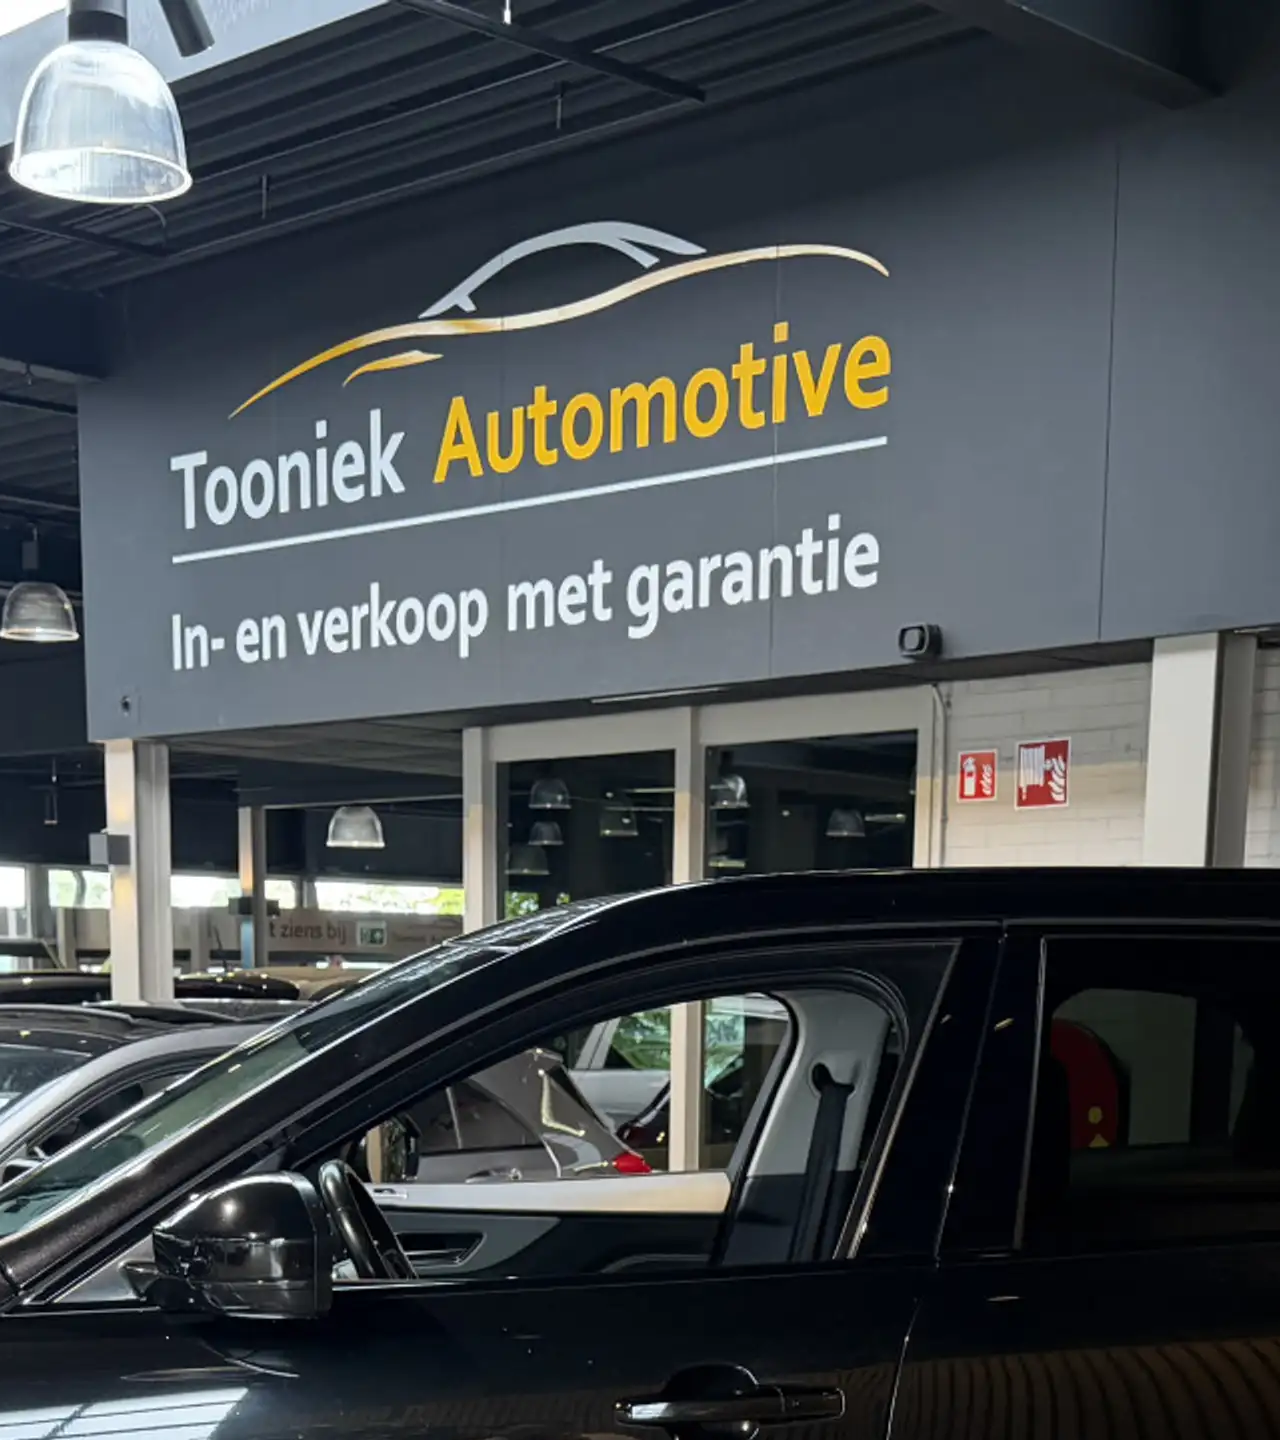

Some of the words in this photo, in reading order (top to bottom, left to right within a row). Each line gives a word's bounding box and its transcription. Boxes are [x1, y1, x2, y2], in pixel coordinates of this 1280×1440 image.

[171, 408, 406, 530] Tooniek
[433, 321, 892, 484] Automotive
[172, 613, 225, 671] In-
[236, 614, 287, 664] en
[297, 582, 489, 659] verkoop
[508, 560, 613, 632] met
[627, 514, 880, 640] garantie
[280, 919, 323, 939] ziens
[326, 918, 347, 946] bij
